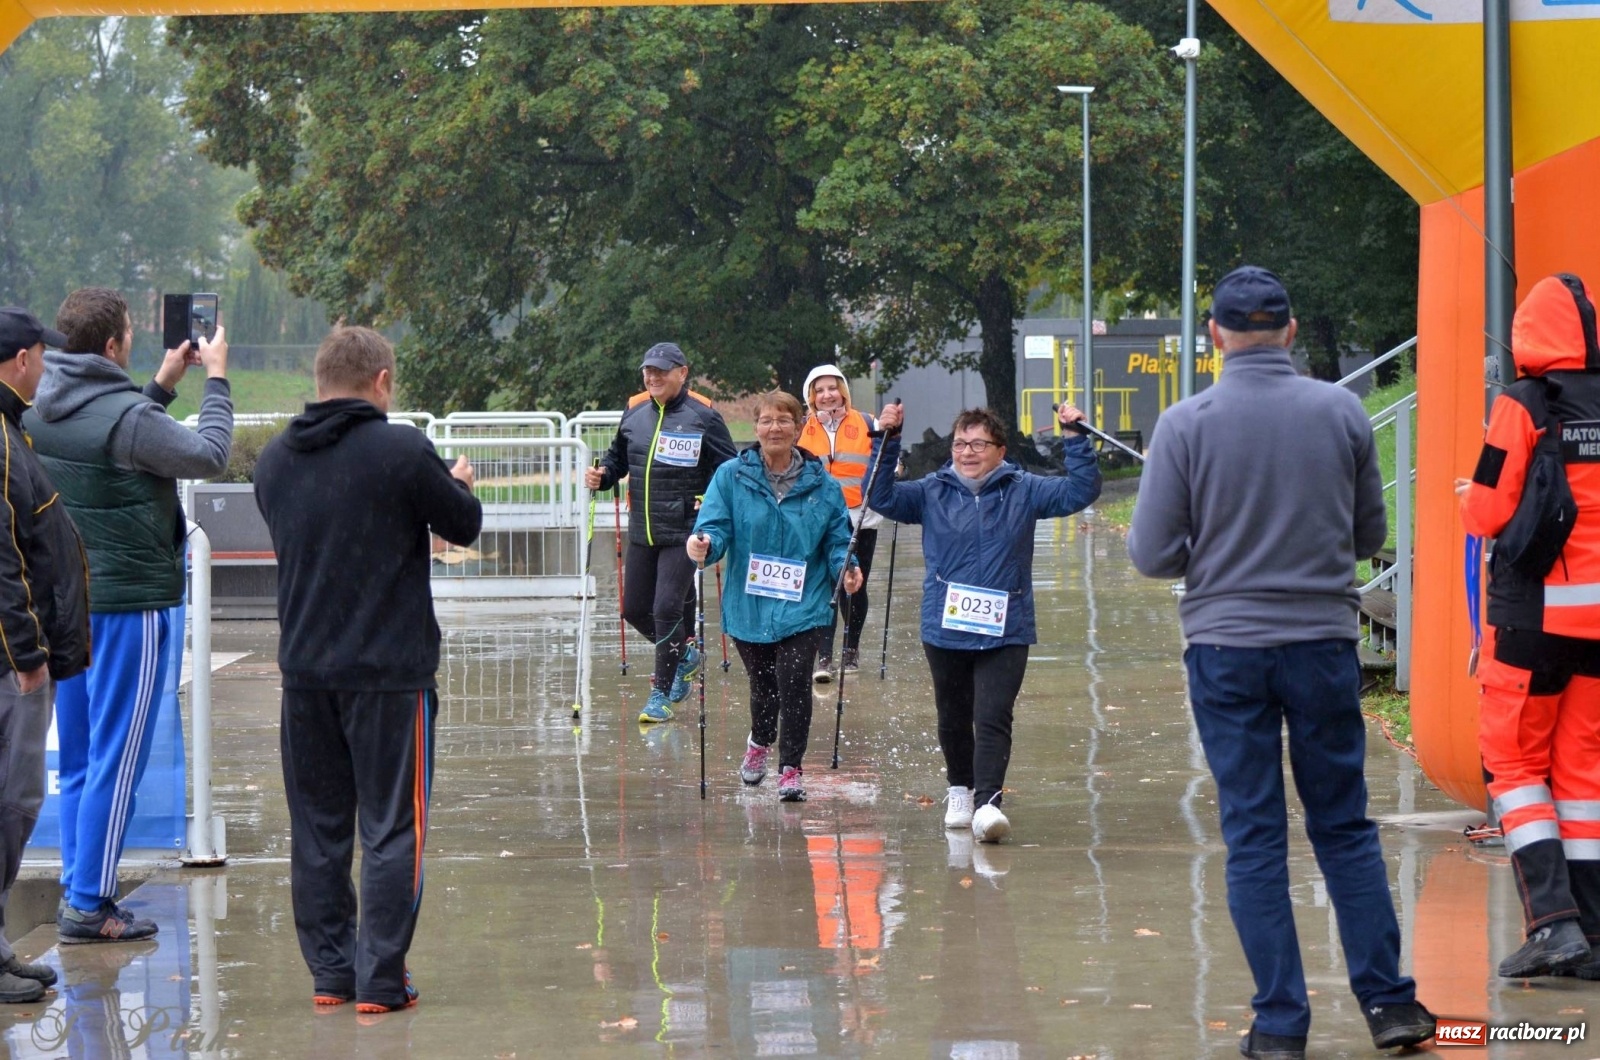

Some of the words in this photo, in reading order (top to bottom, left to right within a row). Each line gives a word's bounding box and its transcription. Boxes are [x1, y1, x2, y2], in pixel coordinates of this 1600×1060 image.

[1562, 428, 1600, 441] RATO
[669, 439, 692, 451] 060
[762, 563, 791, 580] 026
[961, 596, 992, 615] 023
